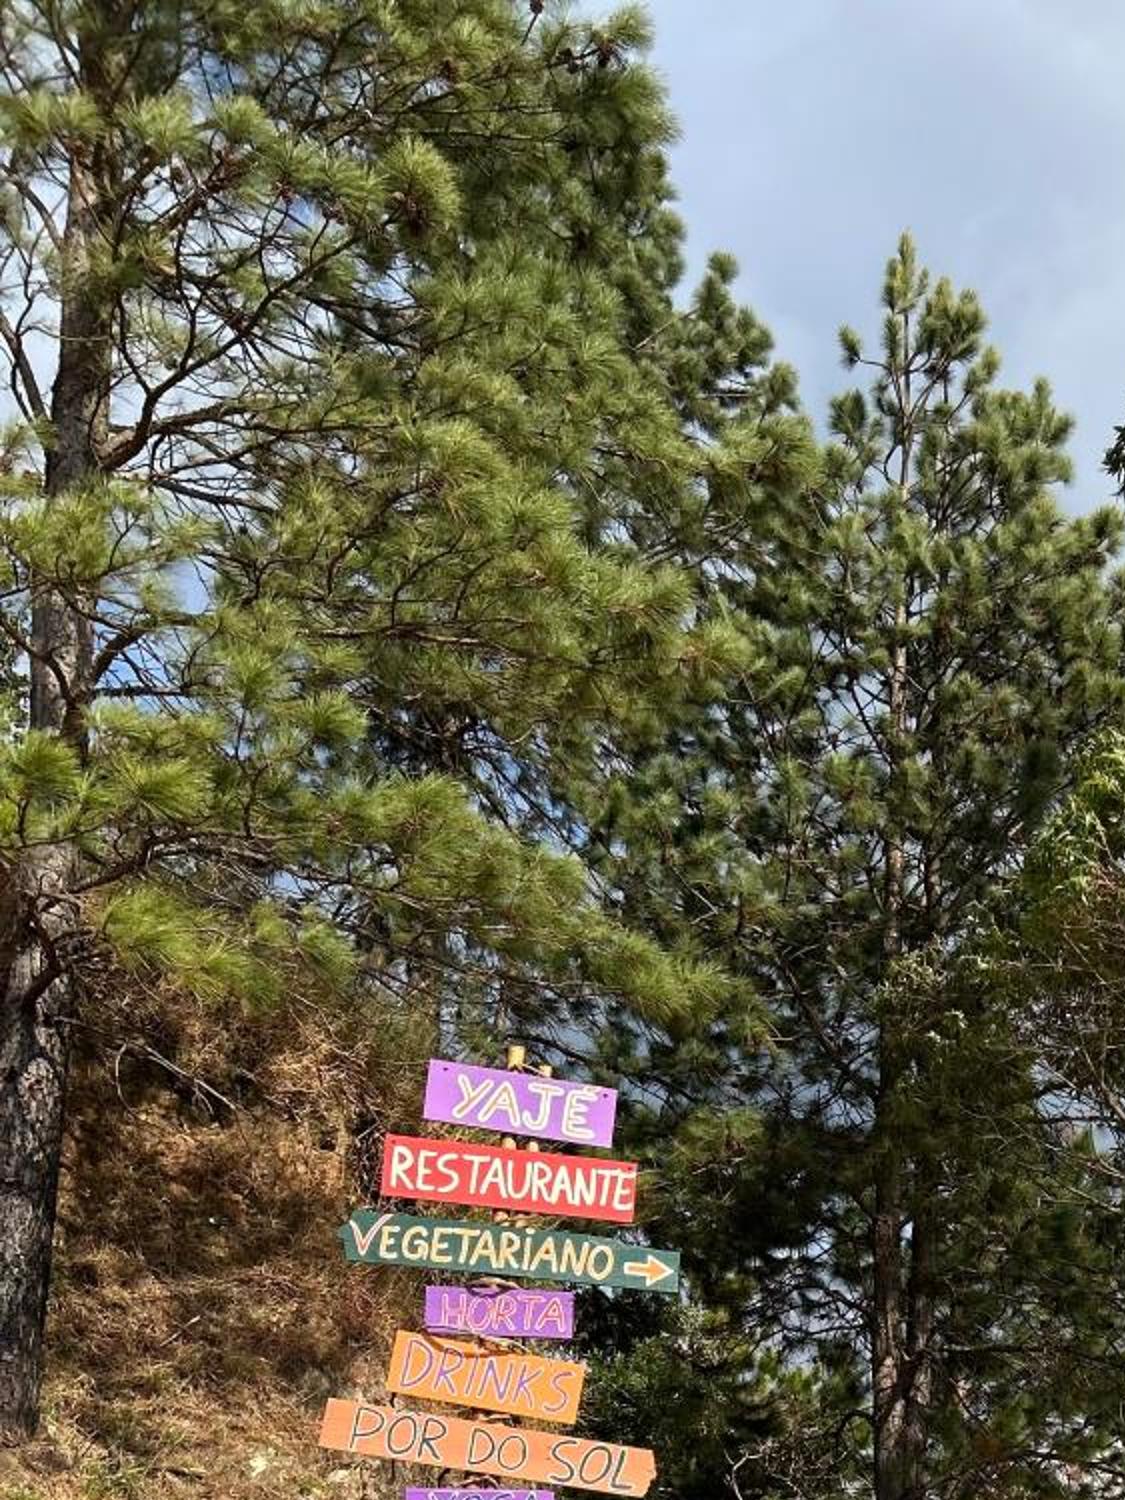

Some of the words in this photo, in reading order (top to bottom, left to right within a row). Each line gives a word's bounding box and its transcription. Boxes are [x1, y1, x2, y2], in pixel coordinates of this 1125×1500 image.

[390, 1145, 637, 1211] RESTAURANTE
[440, 1293, 567, 1334] HORTA
[399, 1338, 576, 1415] DRINKS
[348, 1405, 447, 1461] POR
[467, 1427, 528, 1472] DO
[549, 1440, 634, 1491] SOL
